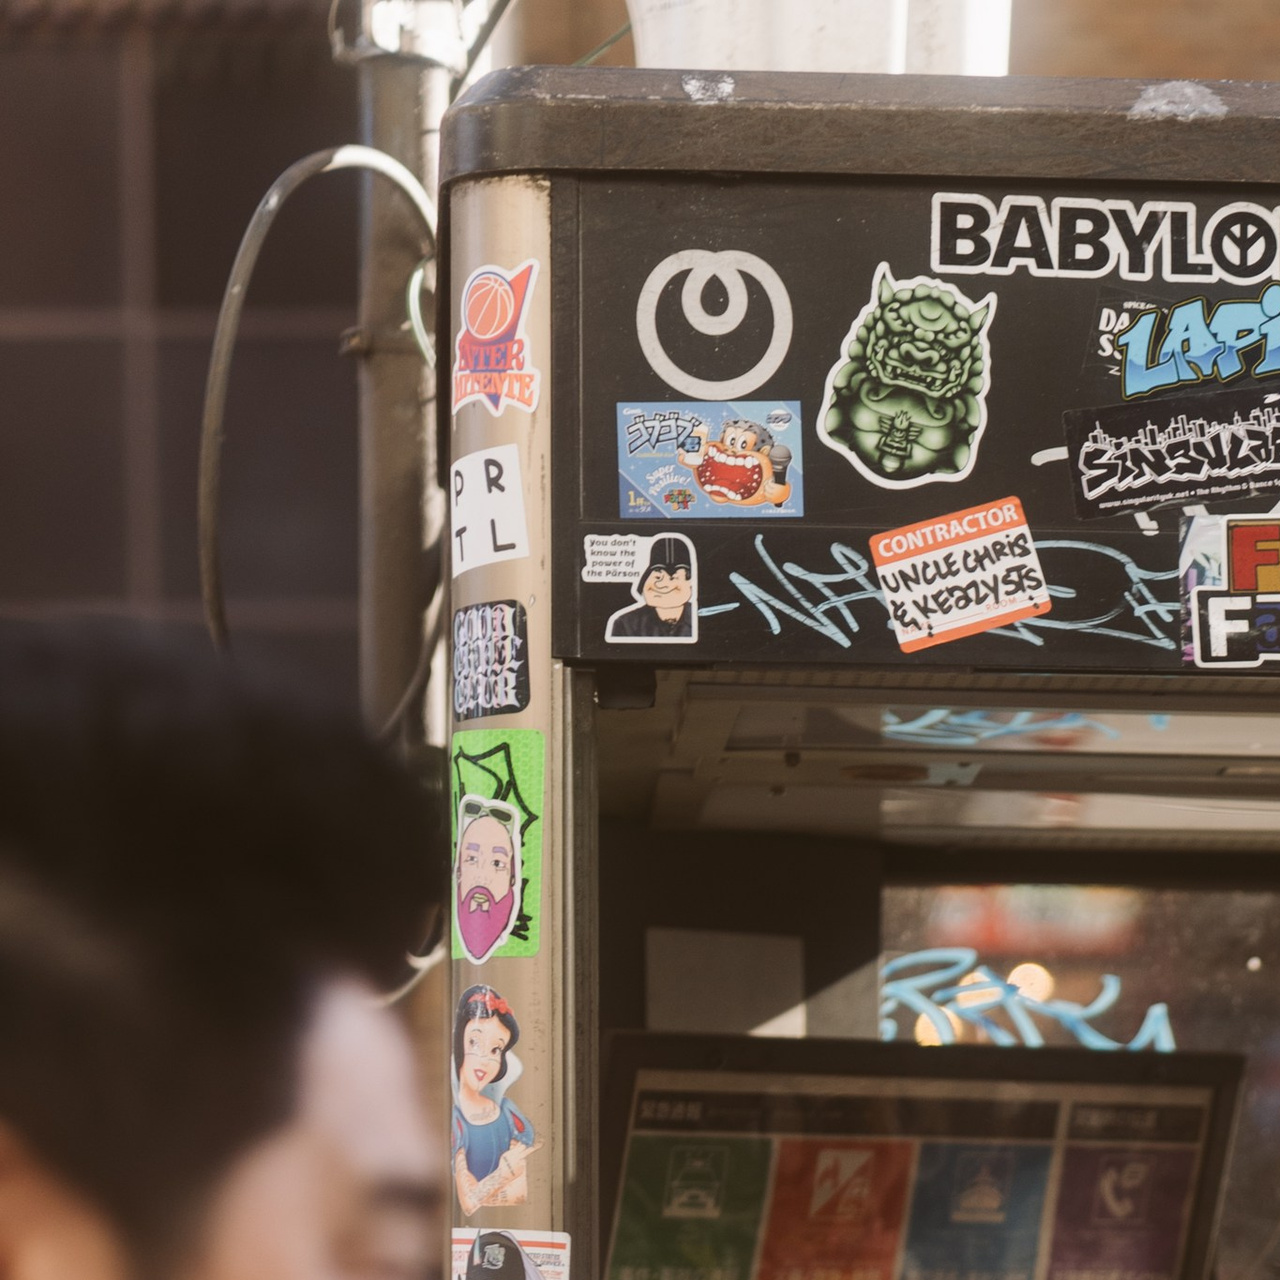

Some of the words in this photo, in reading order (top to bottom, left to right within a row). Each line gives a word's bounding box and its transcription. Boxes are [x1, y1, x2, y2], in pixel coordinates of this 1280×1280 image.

[484, 458, 505, 494] R
[490, 518, 517, 553] L
[878, 504, 1019, 558] CONTRACTOR
[610, 538, 636, 547] don't
[590, 549, 617, 557] know
[620, 549, 636, 557] the
[591, 560, 622, 568] power
[624, 559, 636, 568] of
[586, 569, 603, 577] the
[985, 596, 1018, 613] ROOM
